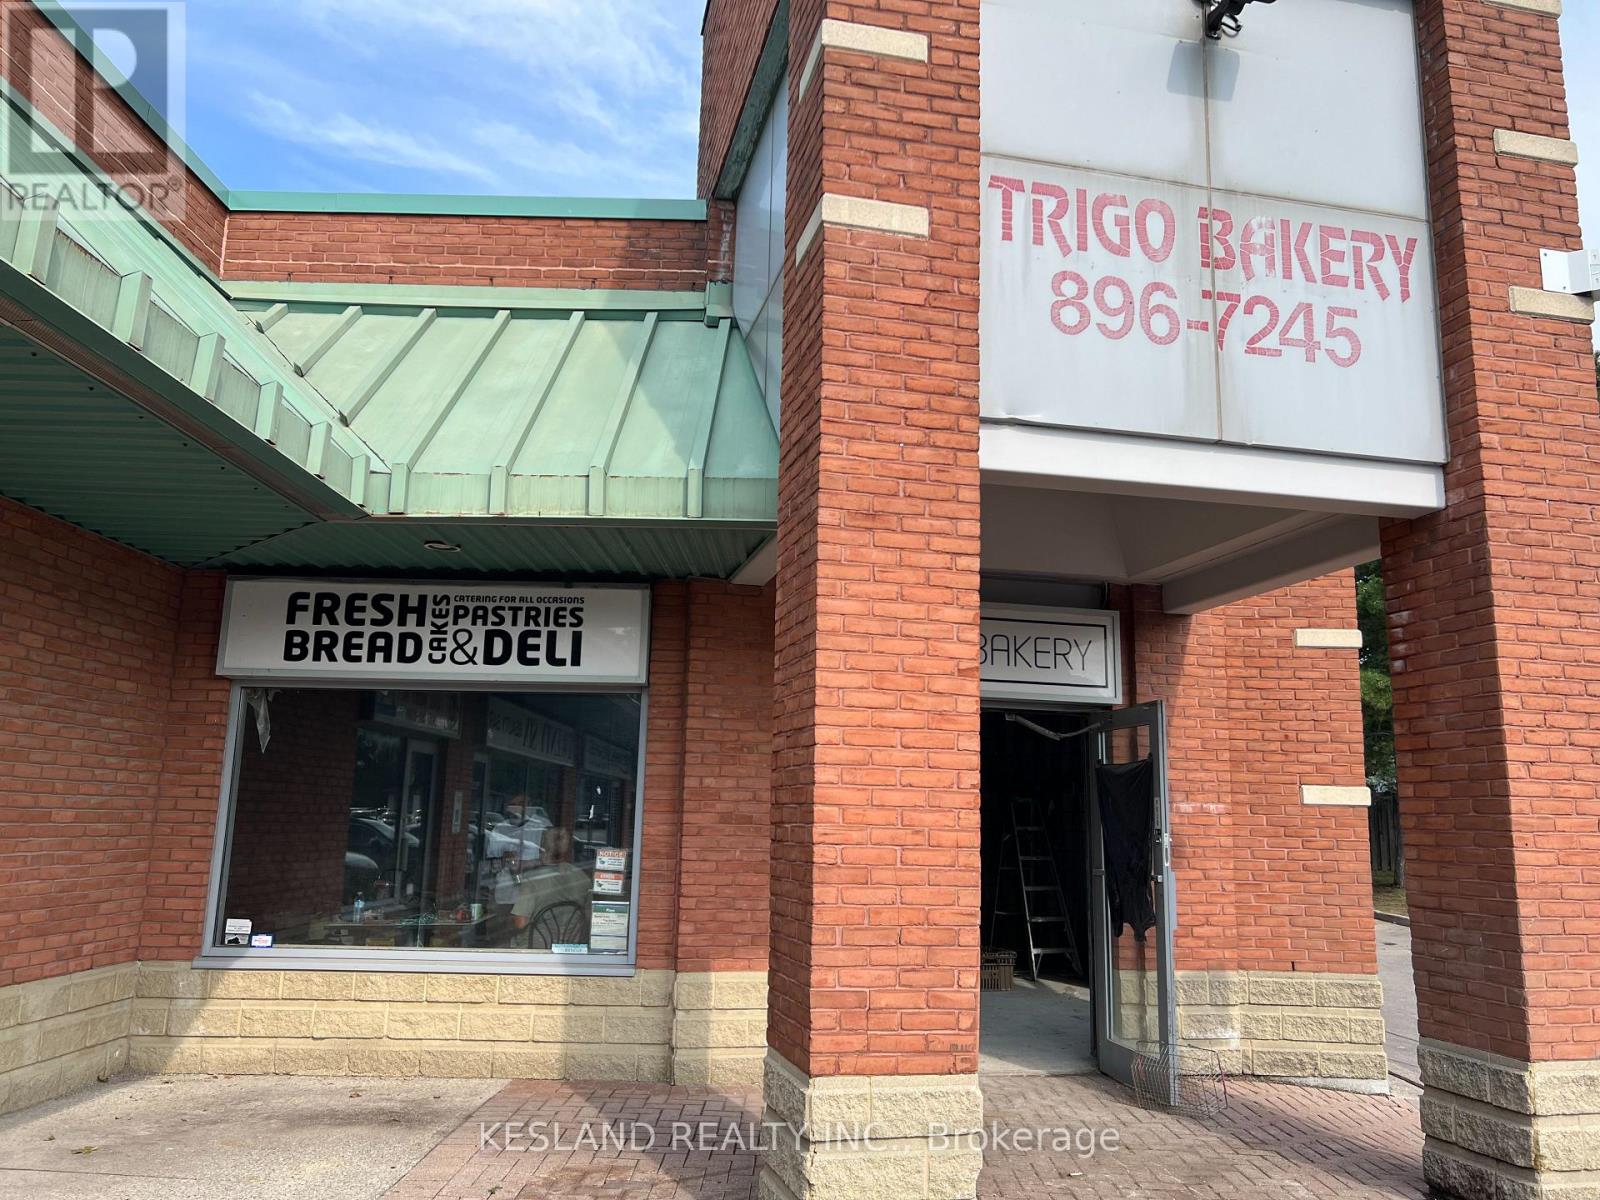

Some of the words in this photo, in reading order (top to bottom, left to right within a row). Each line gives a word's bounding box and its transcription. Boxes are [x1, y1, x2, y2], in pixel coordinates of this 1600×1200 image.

[988, 175, 1176, 263] TRIGO
[1198, 206, 1418, 303] BAKERY
[1051, 270, 1362, 369] 896-7245
[286, 592, 427, 627] FRESH
[452, 604, 584, 628] PASTRIES
[454, 595, 497, 603] CATERING
[499, 596, 517, 604] FOR
[519, 596, 534, 604] ALL
[536, 596, 585, 605] OCCASIONS
[283, 629, 423, 664] BREAD
[428, 594, 450, 664] CAKES
[450, 628, 478, 666] &
[483, 628, 583, 667] DELI
